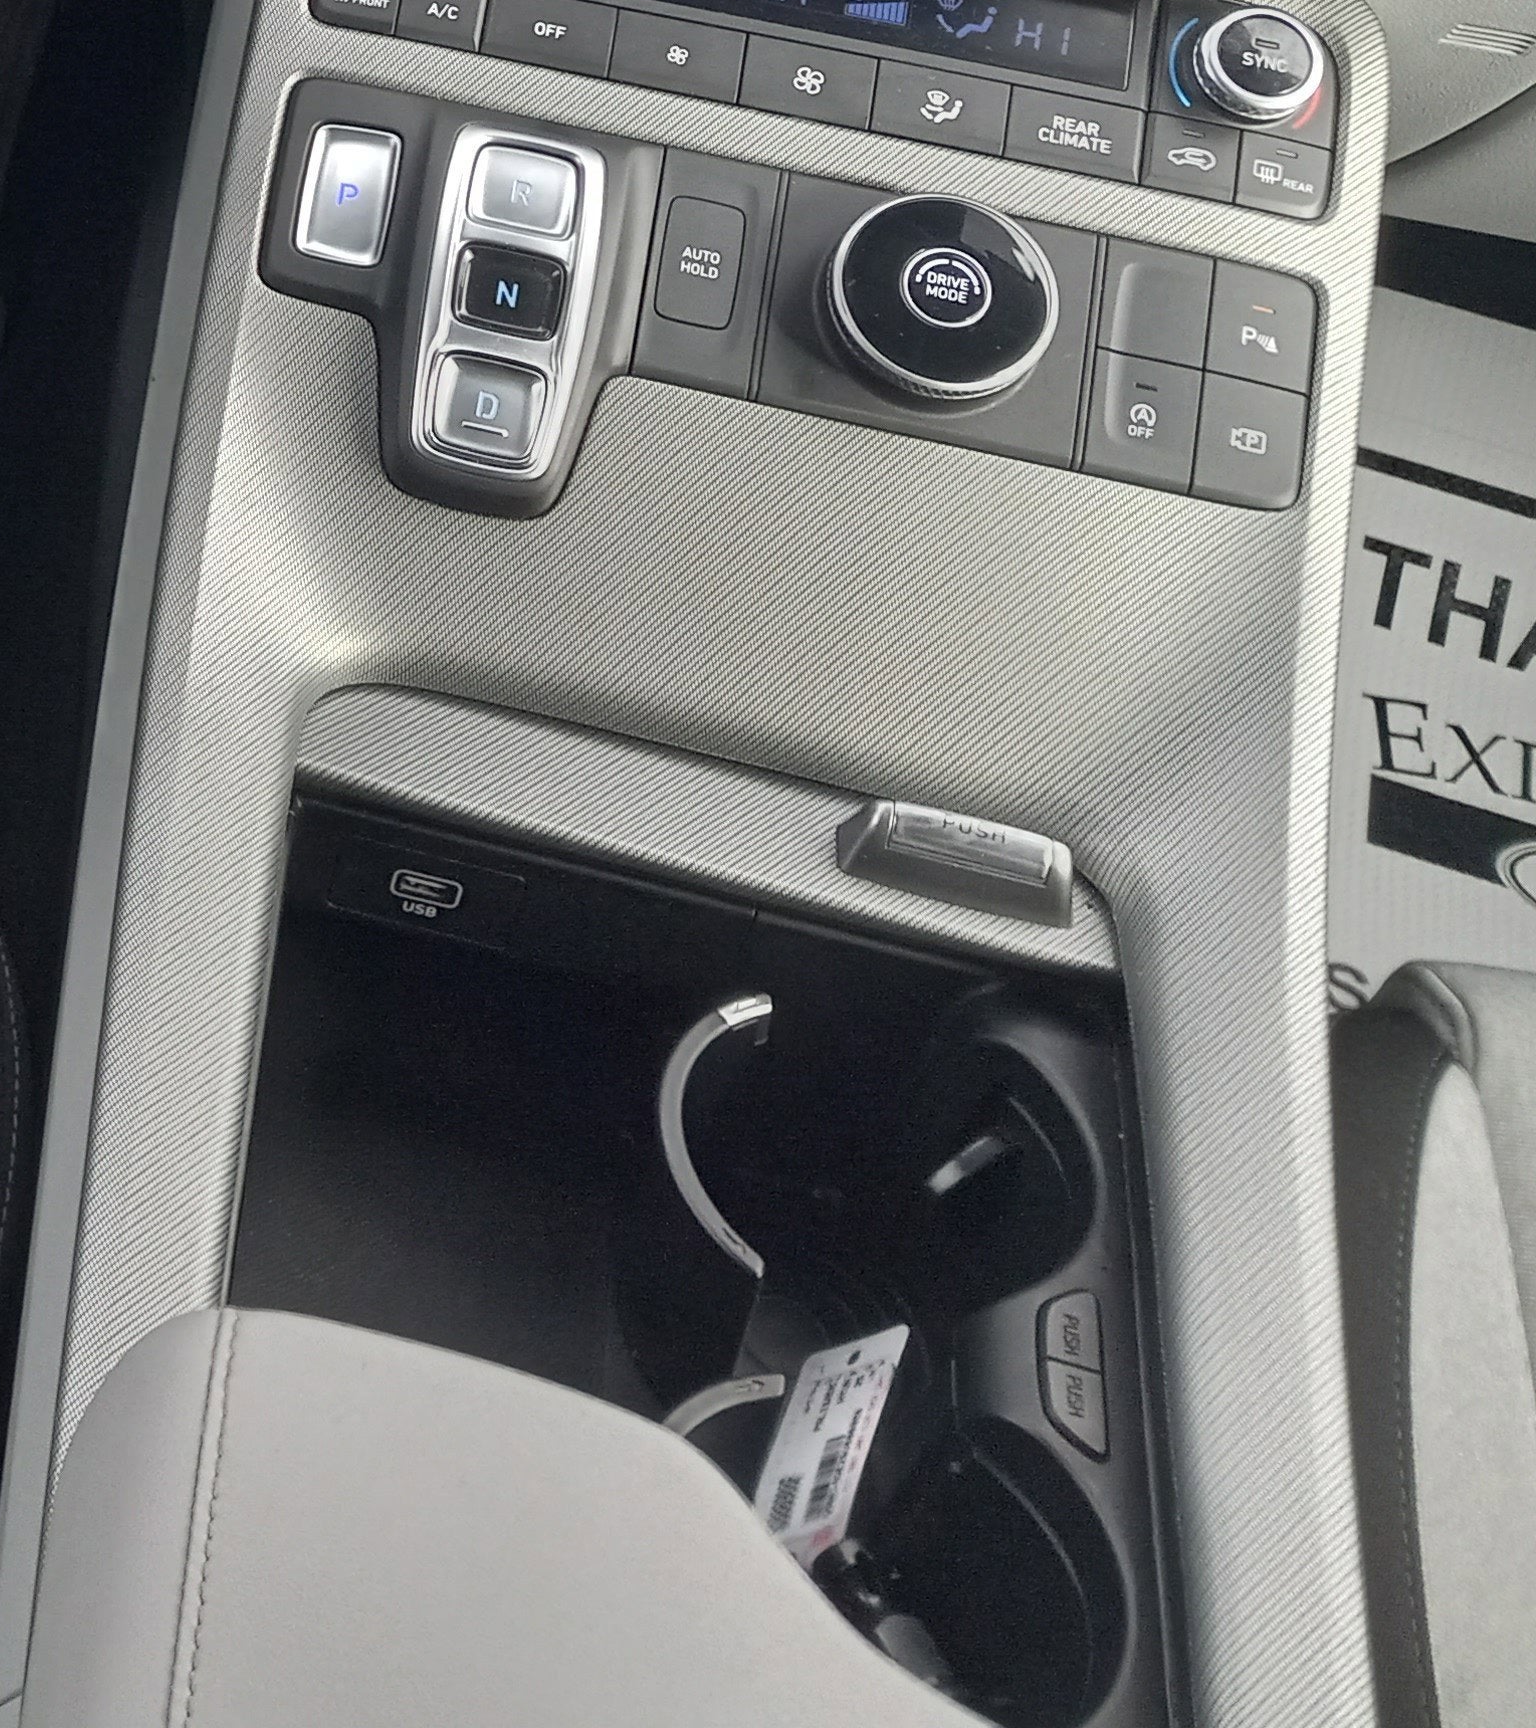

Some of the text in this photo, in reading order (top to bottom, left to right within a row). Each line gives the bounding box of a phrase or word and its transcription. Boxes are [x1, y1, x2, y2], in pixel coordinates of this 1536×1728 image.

[427, 2, 460, 20] A/C
[533, 21, 567, 39] OFF
[1241, 51, 1289, 73] SYNC
[1053, 115, 1101, 138] REAR
[1038, 127, 1112, 155] CLIMATE
[336, 182, 360, 206] P
[510, 178, 532, 207] R
[1282, 177, 1314, 194] REAR
[682, 246, 721, 265] AUTO
[680, 260, 719, 279] HOLD
[926, 271, 970, 291] DRIVE
[495, 279, 519, 309] N
[925, 284, 968, 304] MODE
[475, 390, 501, 421] D
[1127, 424, 1155, 439] OFF
[942, 813, 1006, 844] PUSH
[402, 900, 437, 918] USB
[1063, 1313, 1081, 1356] PUSH
[1066, 1374, 1085, 1418] PUSH
